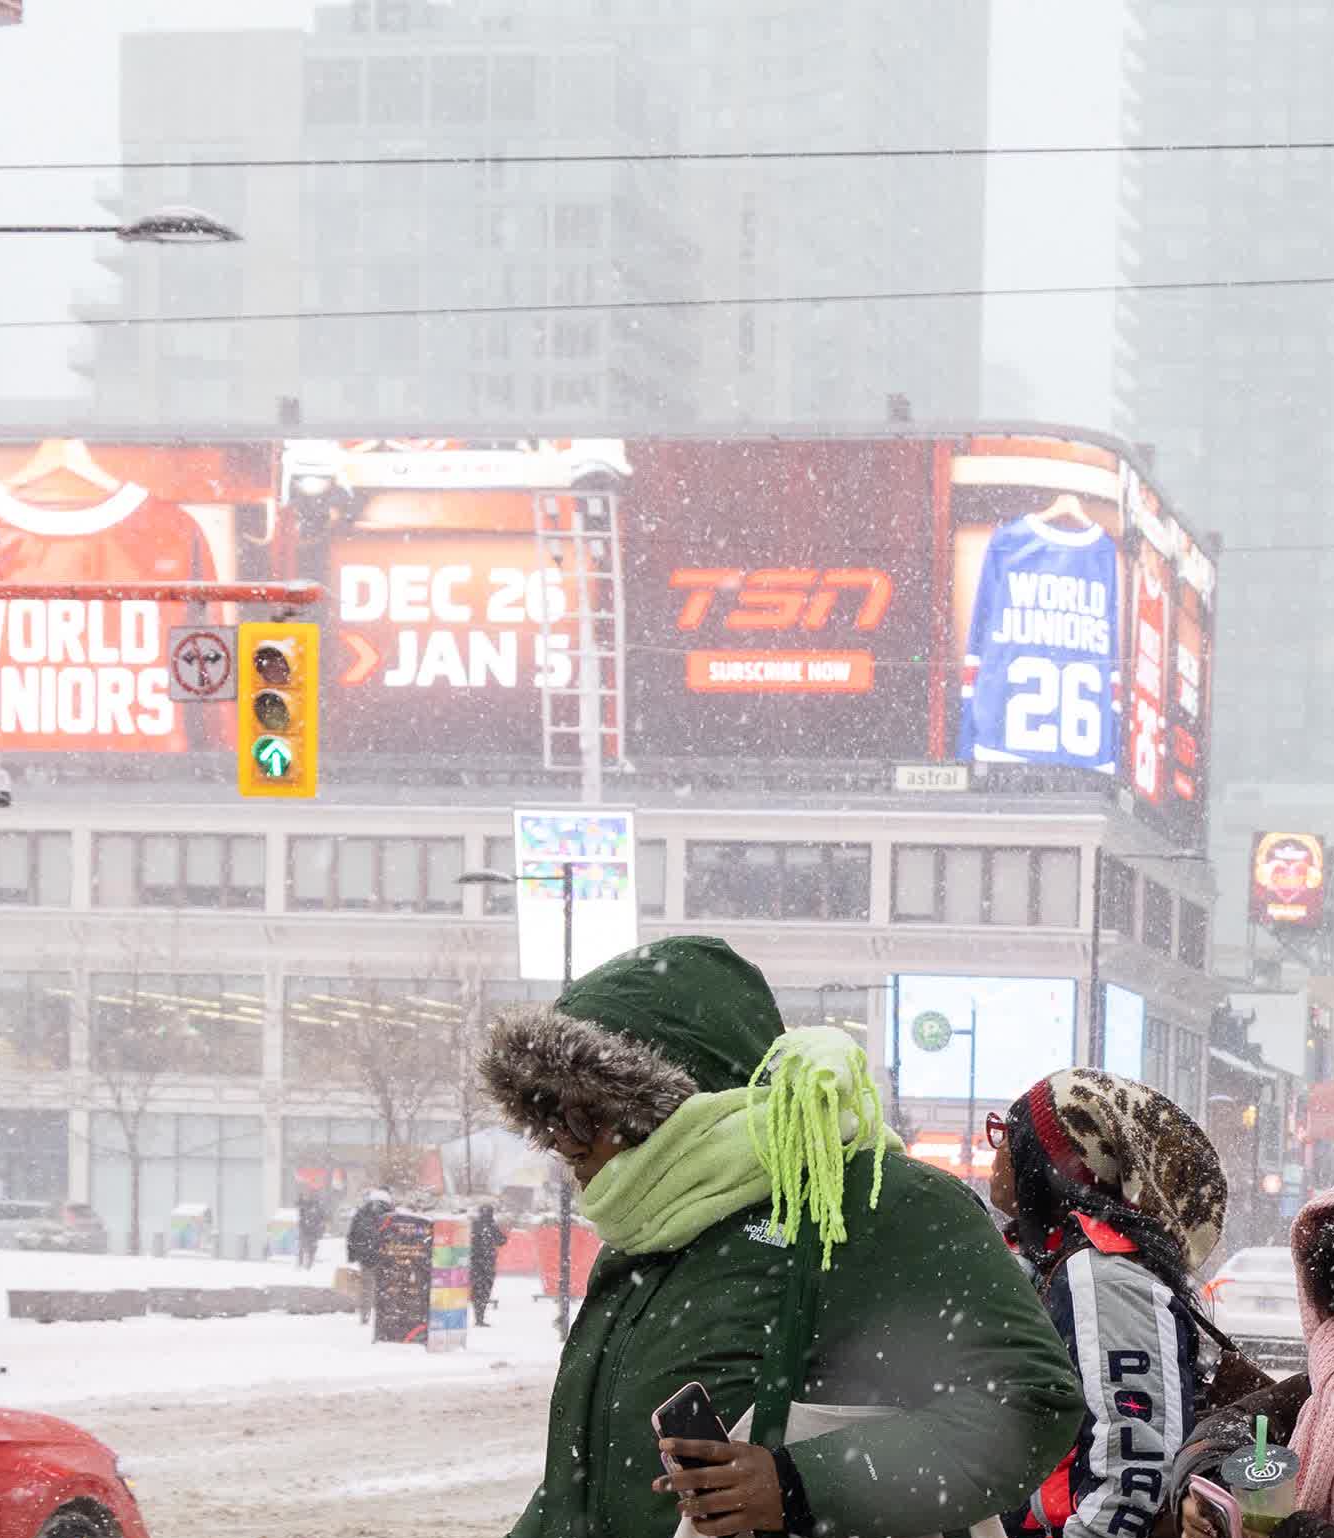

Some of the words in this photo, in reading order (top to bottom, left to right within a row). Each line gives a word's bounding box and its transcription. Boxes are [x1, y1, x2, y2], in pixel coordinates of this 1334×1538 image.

[340, 564, 473, 623] DEC
[486, 567, 567, 623] 26
[668, 568, 894, 631] TSN
[1008, 571, 1108, 614] WORLD
[992, 607, 1110, 656] JUNIORS
[384, 631, 518, 688] JAN
[534, 633, 573, 688] 5
[807, 661, 852, 682] NOW
[1005, 655, 1103, 758] 26
[906, 768, 959, 786] astral
